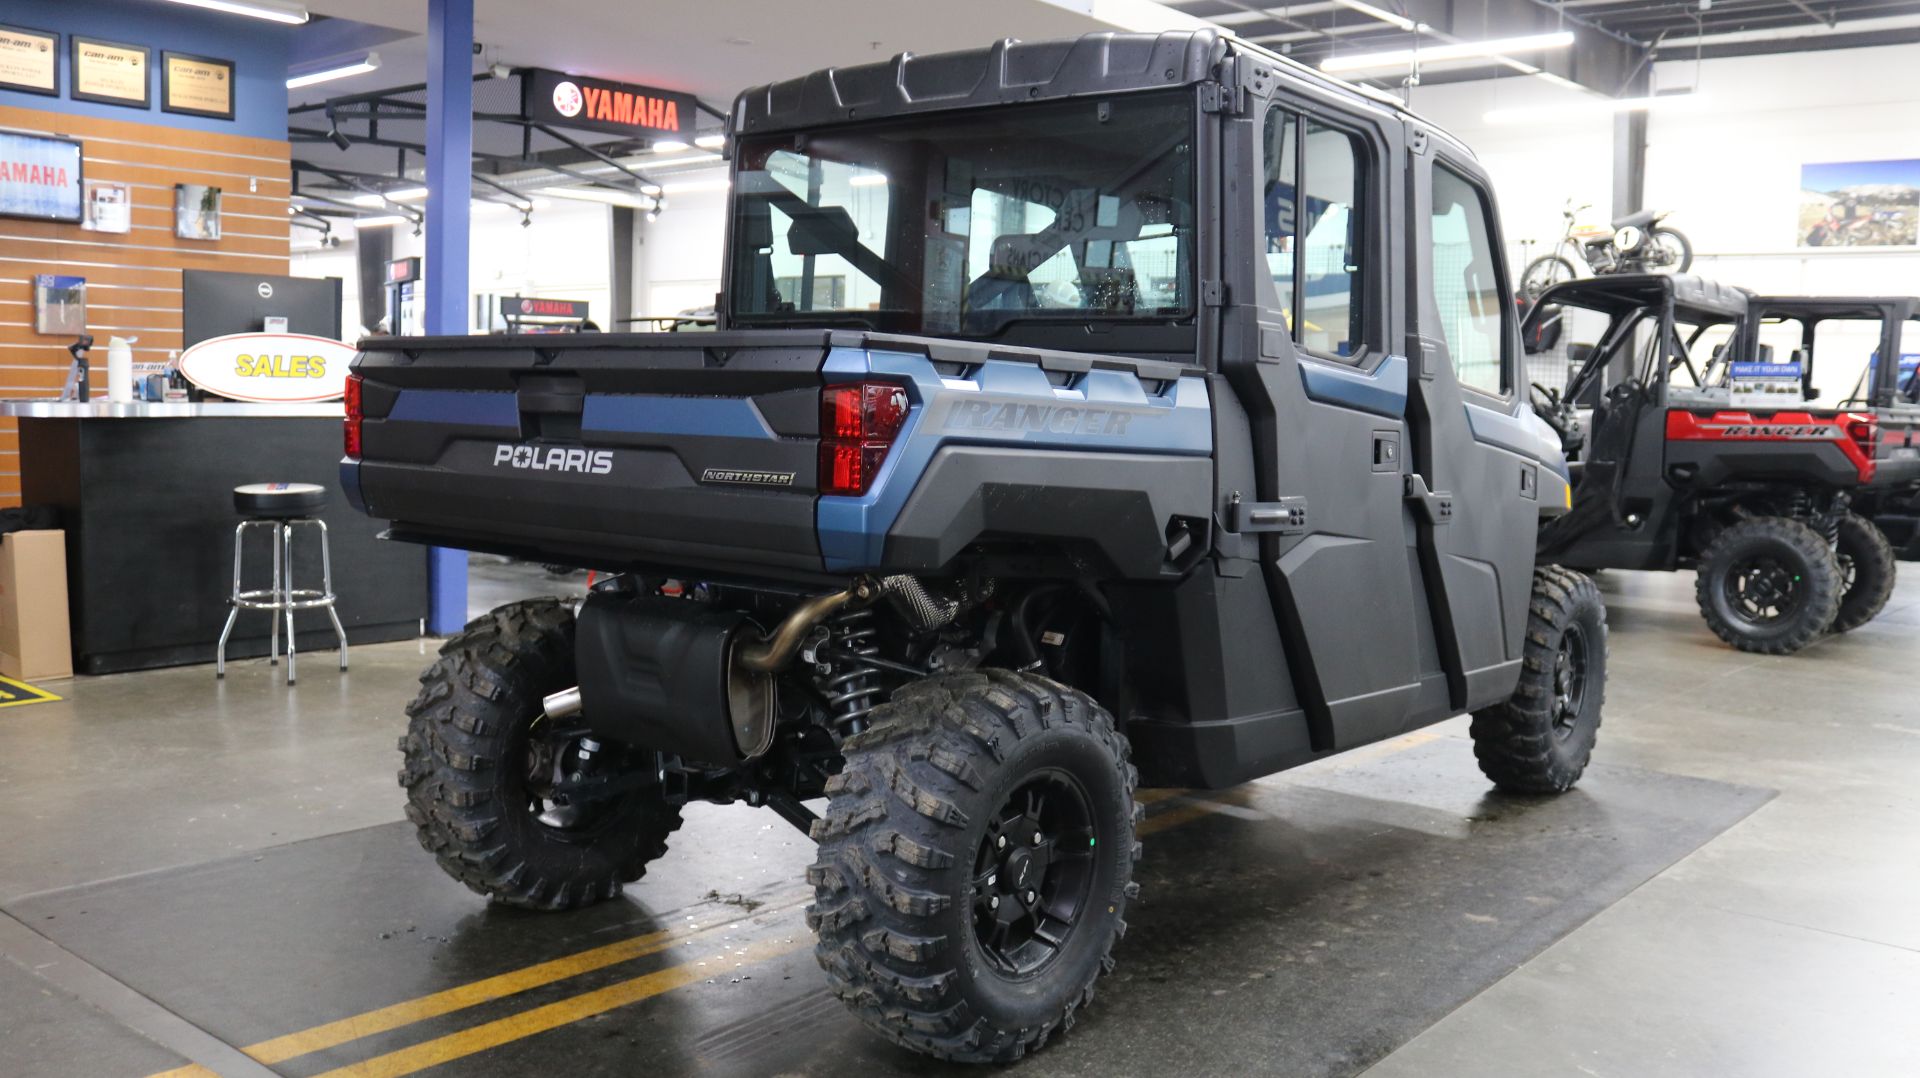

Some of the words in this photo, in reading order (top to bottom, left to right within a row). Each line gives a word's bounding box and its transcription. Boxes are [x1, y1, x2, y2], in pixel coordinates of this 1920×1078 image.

[583, 86, 679, 132] YAMAHA
[1623, 230, 1630, 246] 1
[532, 301, 574, 315] YAMAHA
[234, 353, 327, 378] SALES
[1734, 365, 1752, 374] MAKE
[1754, 365, 1760, 374] IT
[1761, 365, 1780, 374] YOUR
[1781, 365, 1798, 374] OWN
[945, 399, 1133, 435] RANGER
[1723, 426, 1831, 436] RANGER
[493, 444, 614, 475] POLARIS
[706, 471, 792, 484] NORTHSTAR
